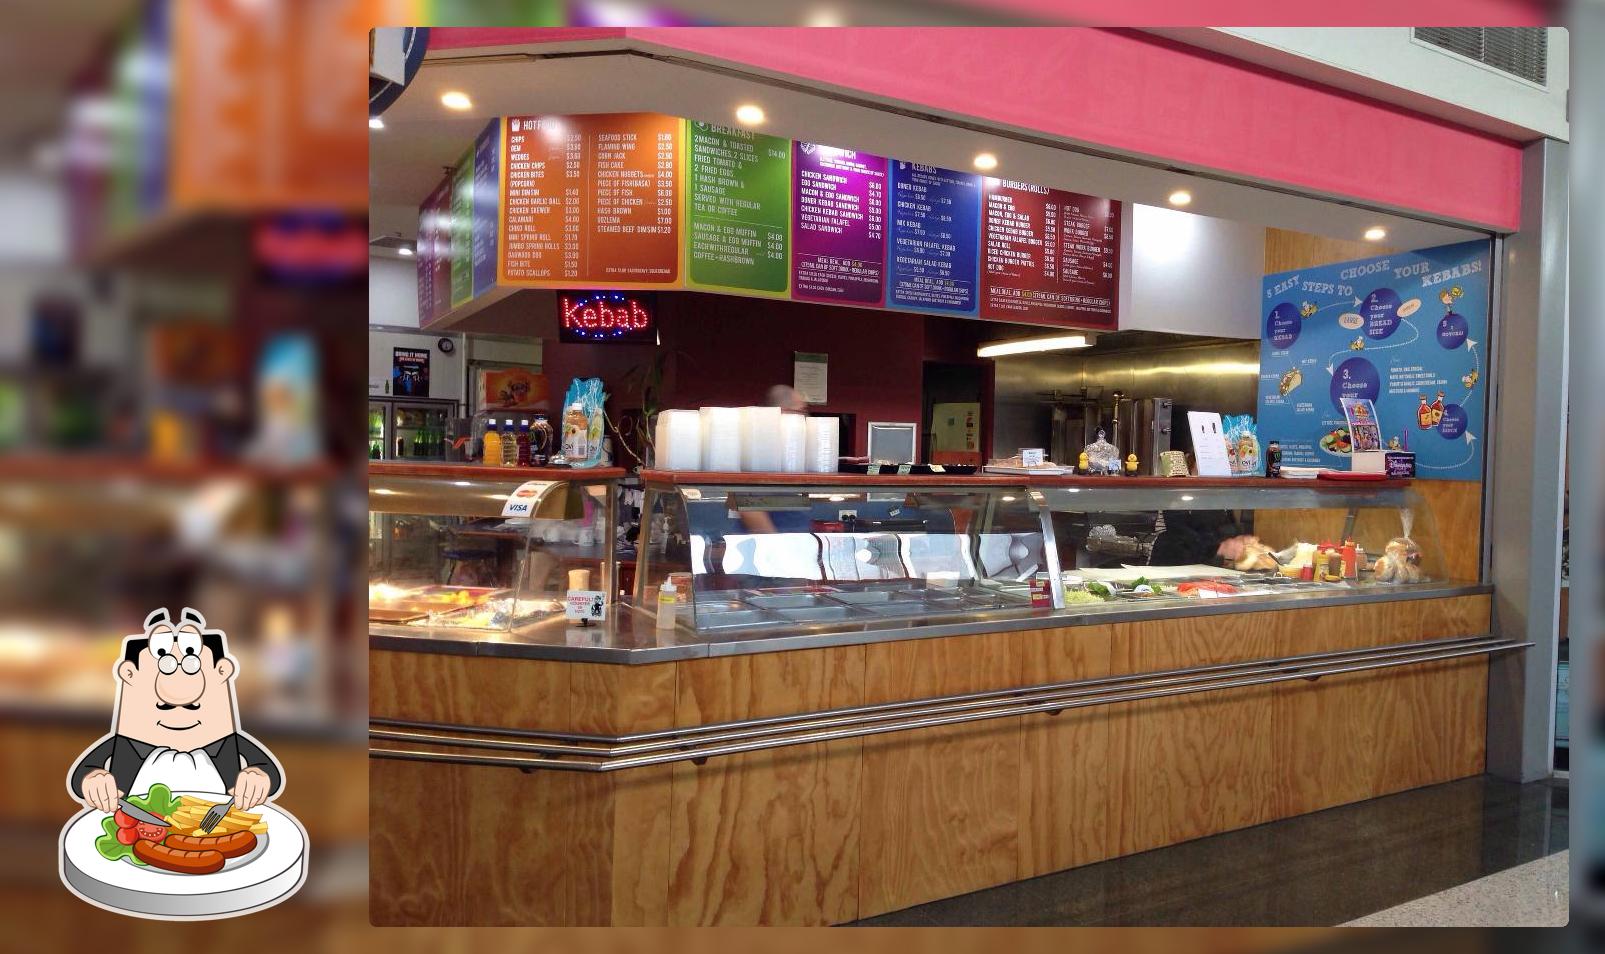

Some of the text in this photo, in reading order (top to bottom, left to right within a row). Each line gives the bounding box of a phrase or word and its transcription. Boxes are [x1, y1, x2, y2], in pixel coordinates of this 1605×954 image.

[523, 121, 536, 131] HOT
[1340, 260, 1391, 281] CHOOSE
[1393, 262, 1430, 280] YOUR
[1421, 260, 1483, 287] KEBABS!
[1274, 275, 1300, 294] EASY
[1301, 281, 1334, 294] STEPS
[1337, 285, 1353, 297] TO
[564, 297, 649, 329] Kebab
